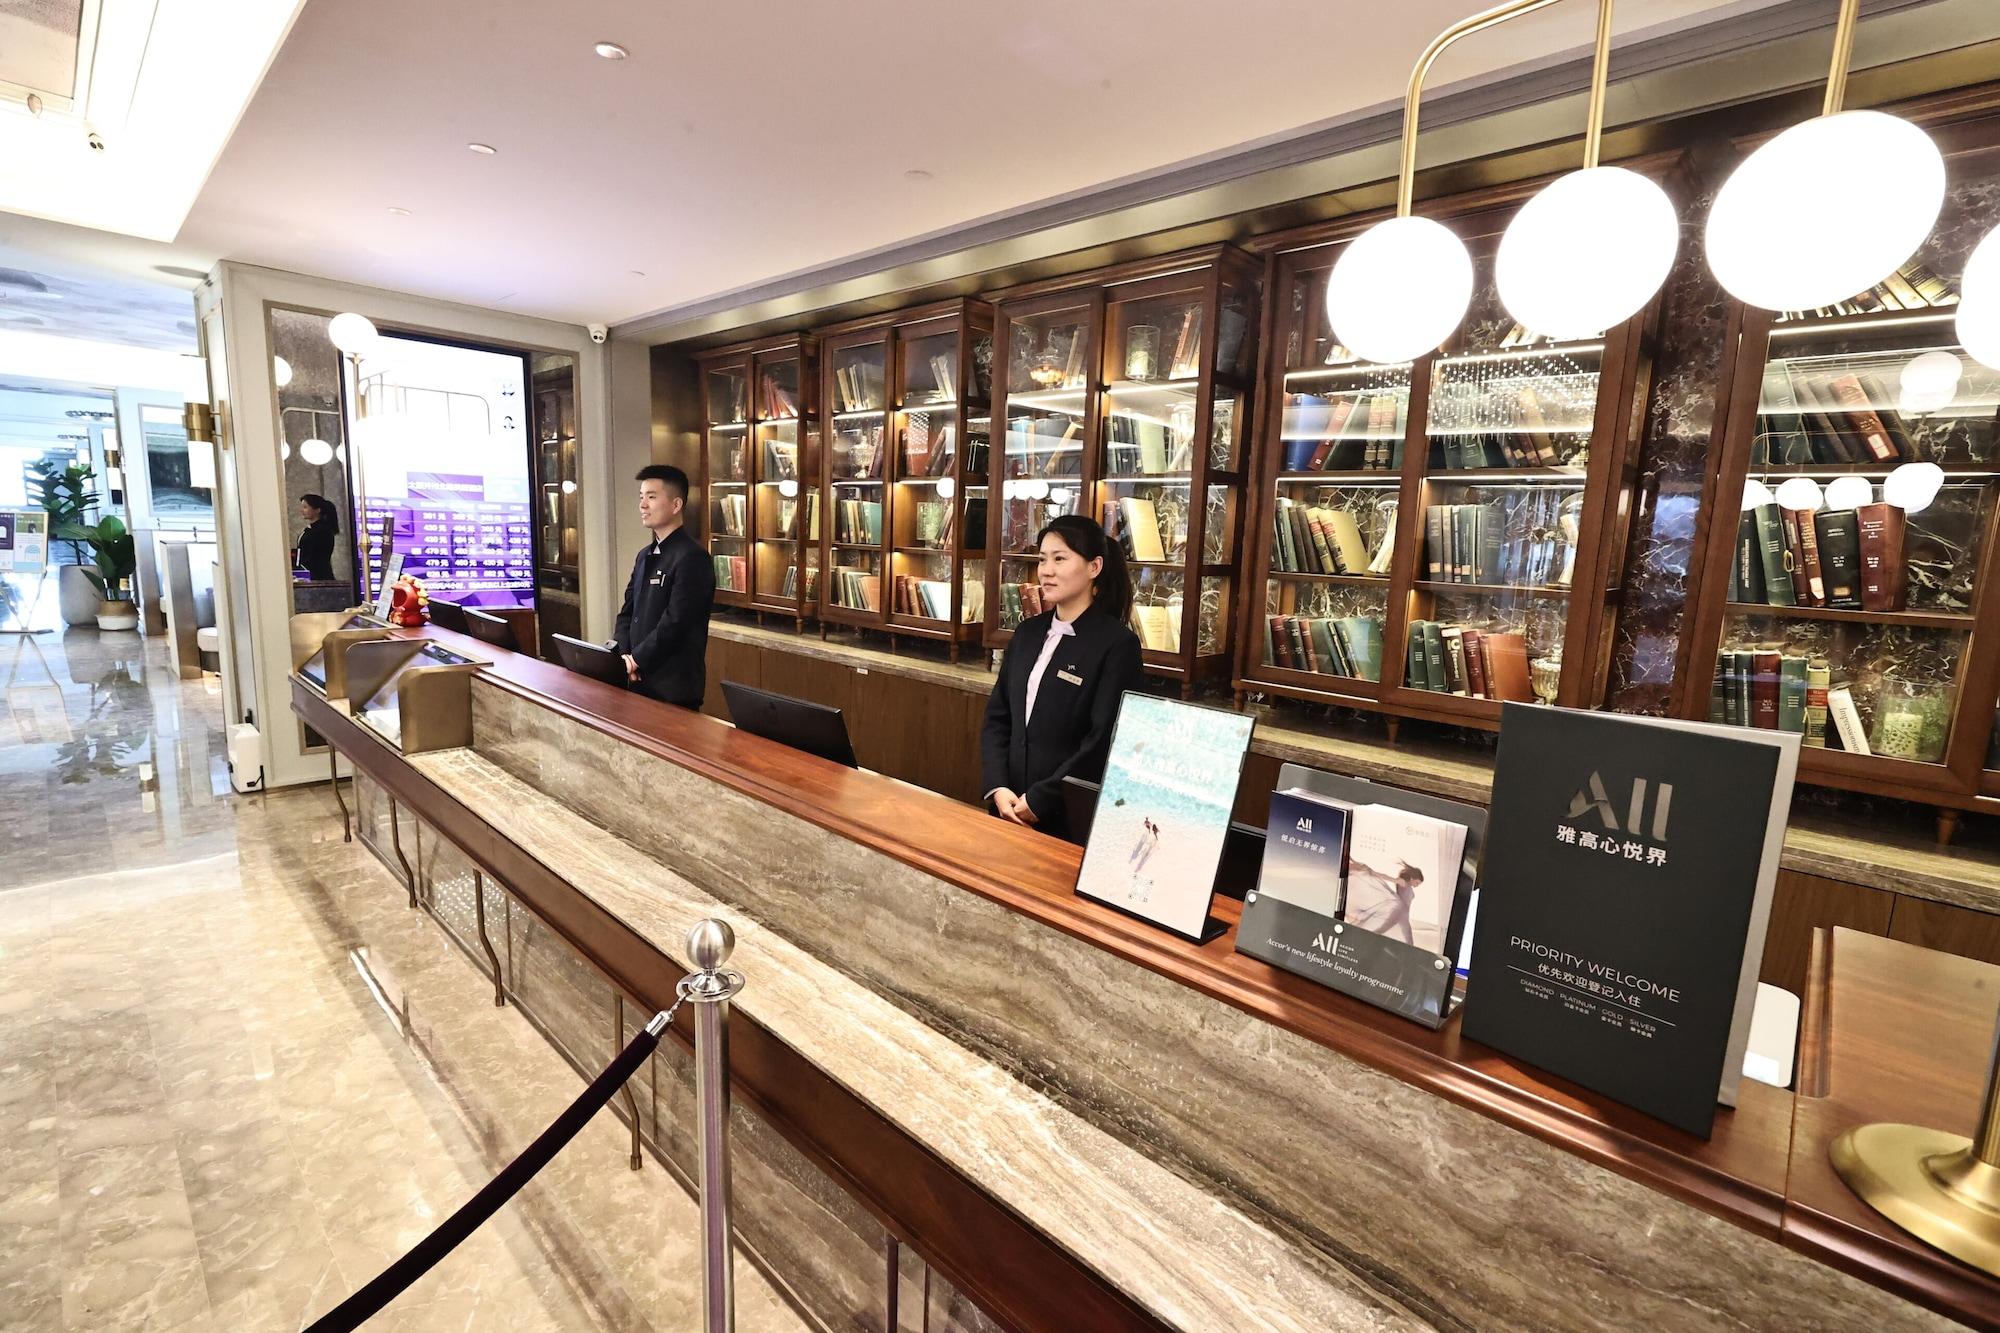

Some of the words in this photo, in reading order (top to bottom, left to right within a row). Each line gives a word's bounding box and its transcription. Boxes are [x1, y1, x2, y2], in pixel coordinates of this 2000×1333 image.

[1839, 707, 1861, 753] Impressionism
[1556, 824, 1668, 867] 雅高心悦界
[1266, 937, 1291, 953] Accor's
[1291, 946, 1306, 958] new
[1306, 951, 1334, 969] lifestyle
[1334, 960, 1359, 979] loyalty
[1359, 971, 1404, 996] programme
[1339, 943, 1354, 952] ACCOR
[1510, 935, 1584, 969] PRIORITY
[1588, 960, 1681, 1004] WELCOME
[1520, 978, 1555, 996] DIAMOND
[1560, 993, 1597, 1011] PLATINUM
[1629, 1018, 1656, 1033] SILVER
[1537, 962, 1641, 1008] 优先欢迎登记入住
